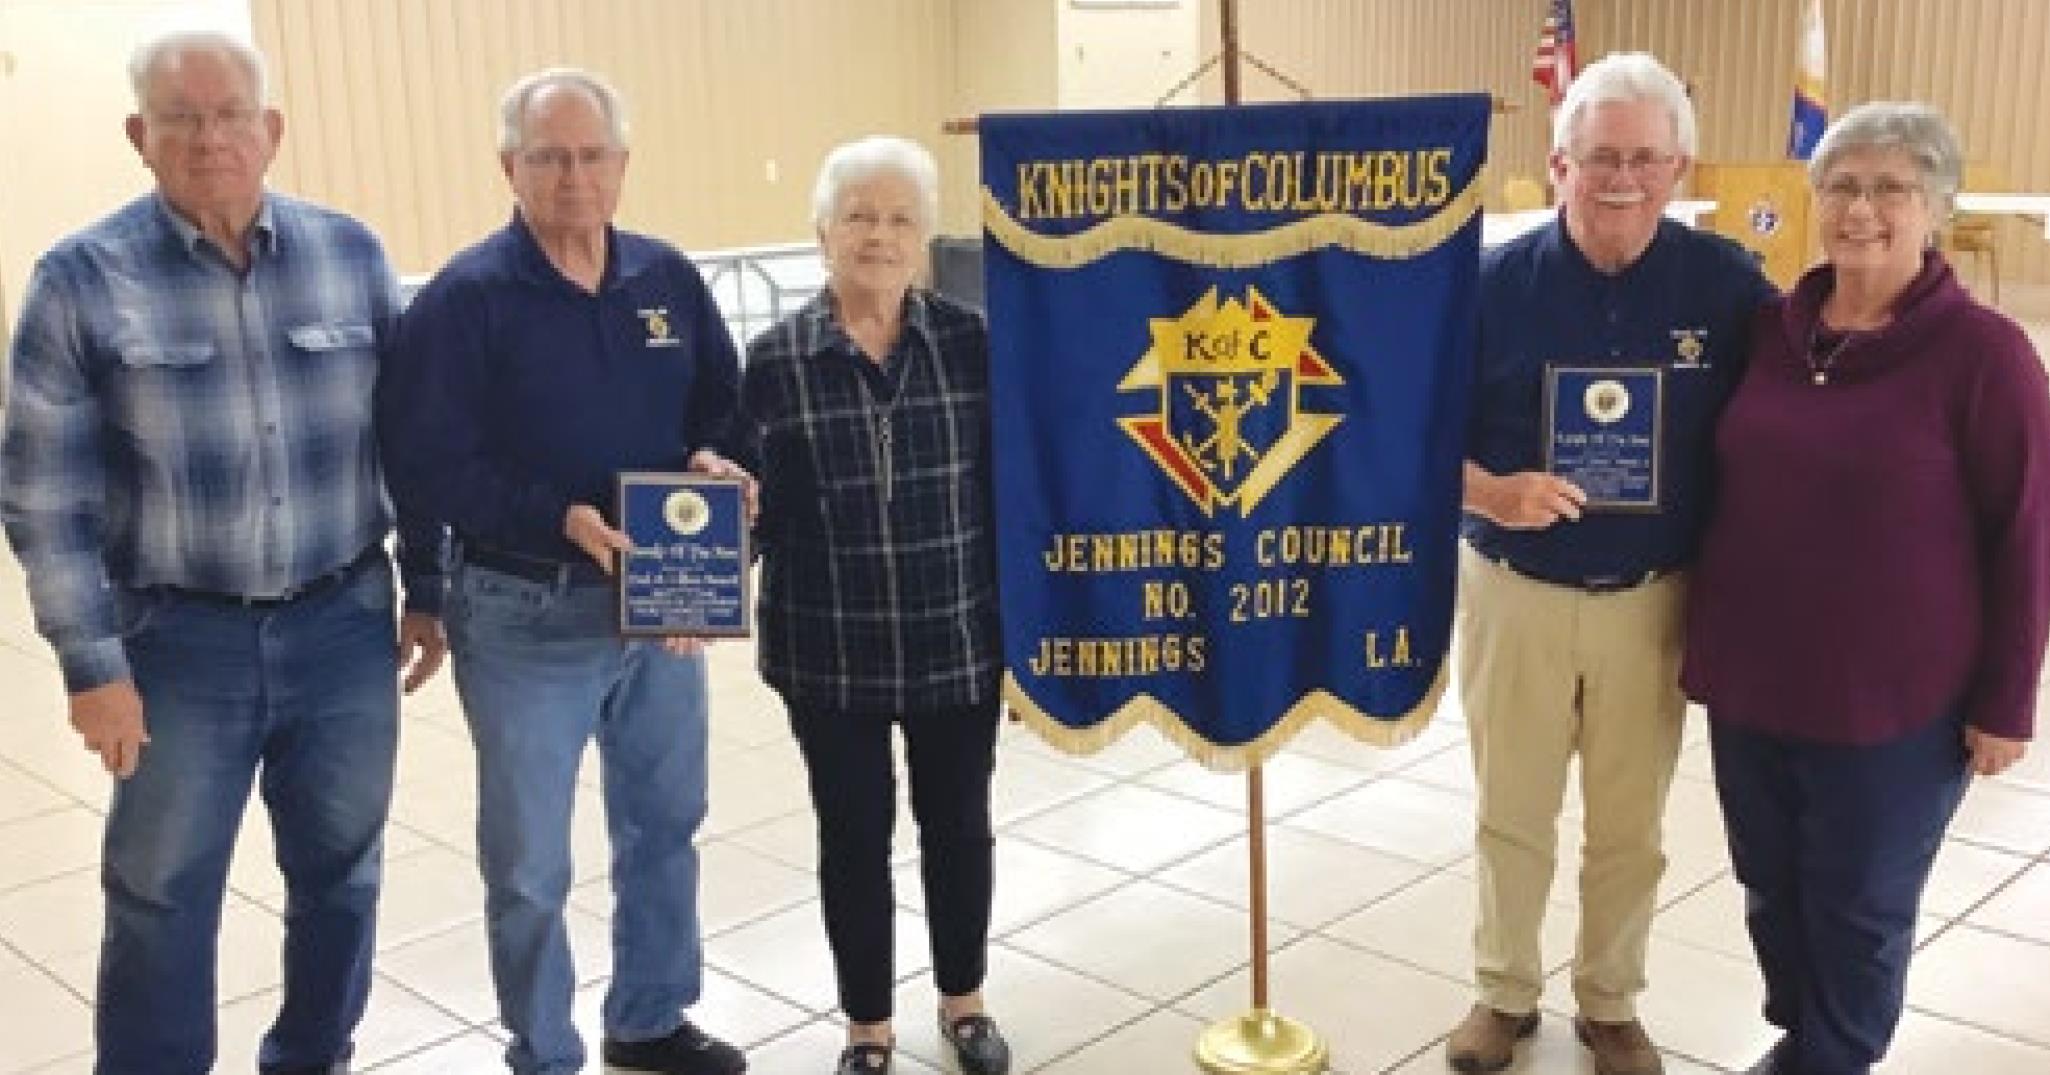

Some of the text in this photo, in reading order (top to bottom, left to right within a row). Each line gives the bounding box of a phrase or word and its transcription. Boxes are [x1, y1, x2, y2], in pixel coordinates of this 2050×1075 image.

[1016, 151, 1188, 221] KNIGHTS
[1240, 147, 1455, 212] COLUMBUS
[1043, 523, 1412, 572] JENNINGS COUNCIL
[1143, 578, 1310, 623] NO. 2012
[1028, 634, 1206, 676] JENNINGS
